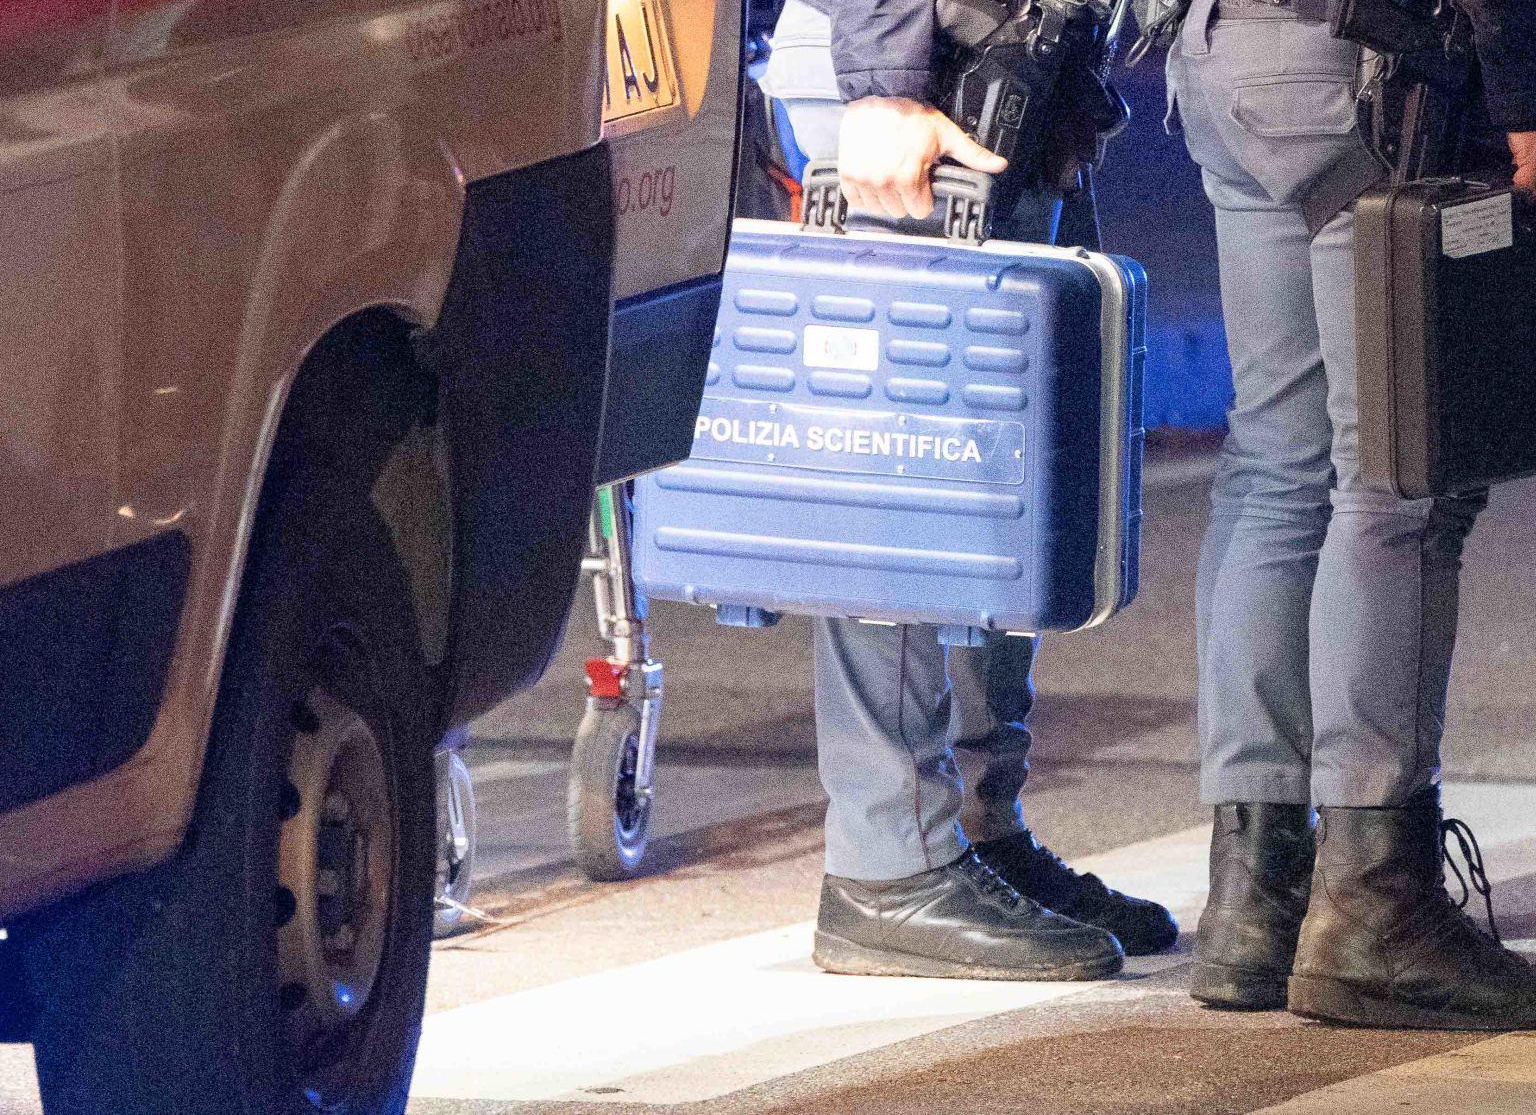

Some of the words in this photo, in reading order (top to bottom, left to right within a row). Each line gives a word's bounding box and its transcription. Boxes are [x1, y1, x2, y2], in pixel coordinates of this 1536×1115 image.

[604, 4, 660, 107] AJ
[695, 417, 800, 449] POLIZIA
[806, 426, 982, 463] SCIENTIFICA
